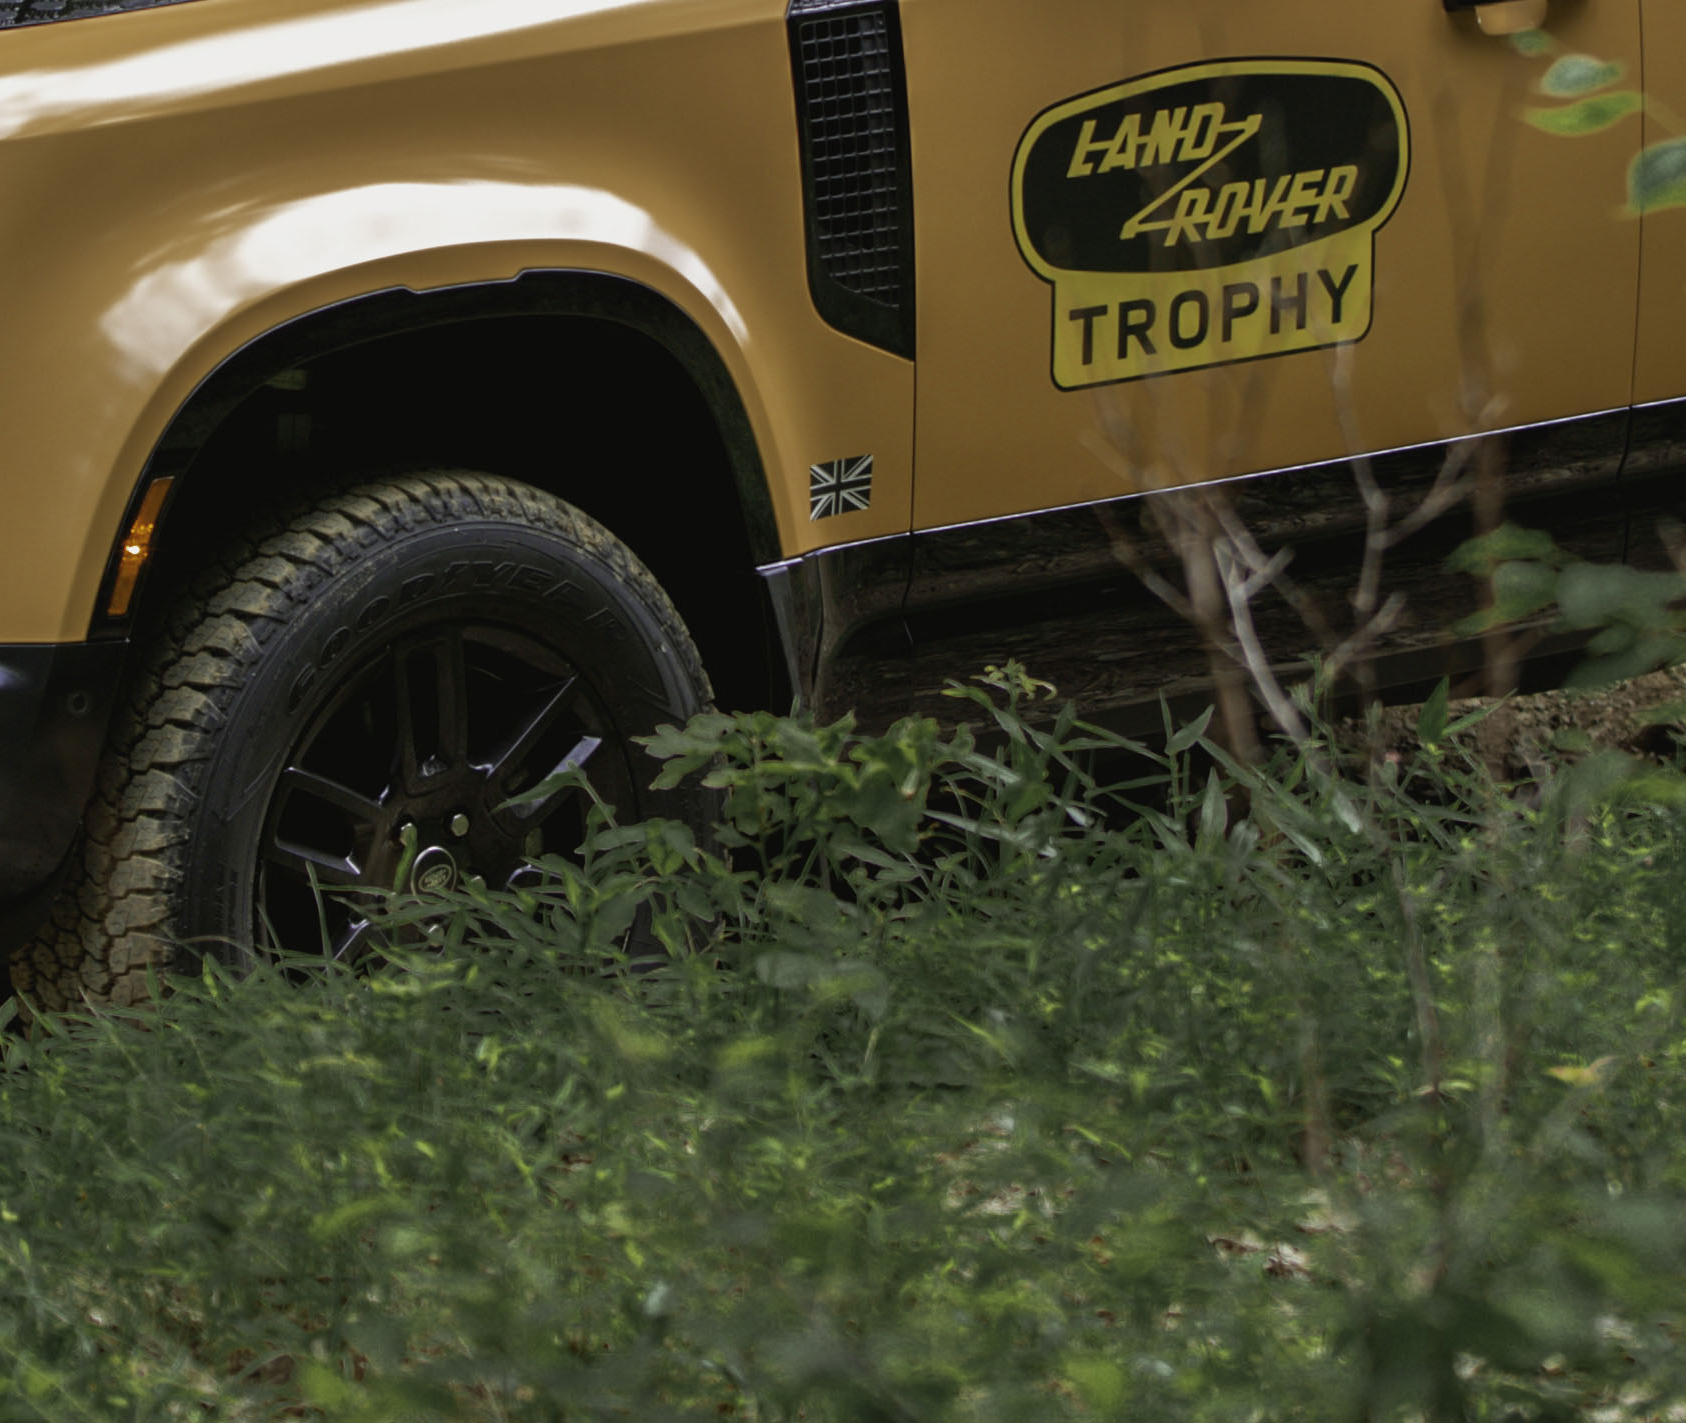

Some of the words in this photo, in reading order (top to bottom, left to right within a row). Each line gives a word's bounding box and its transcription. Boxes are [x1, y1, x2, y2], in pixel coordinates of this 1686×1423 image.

[1067, 102, 1224, 178] LAND
[1164, 165, 1358, 247] ROVER
[1069, 264, 1359, 365] TROPHY
